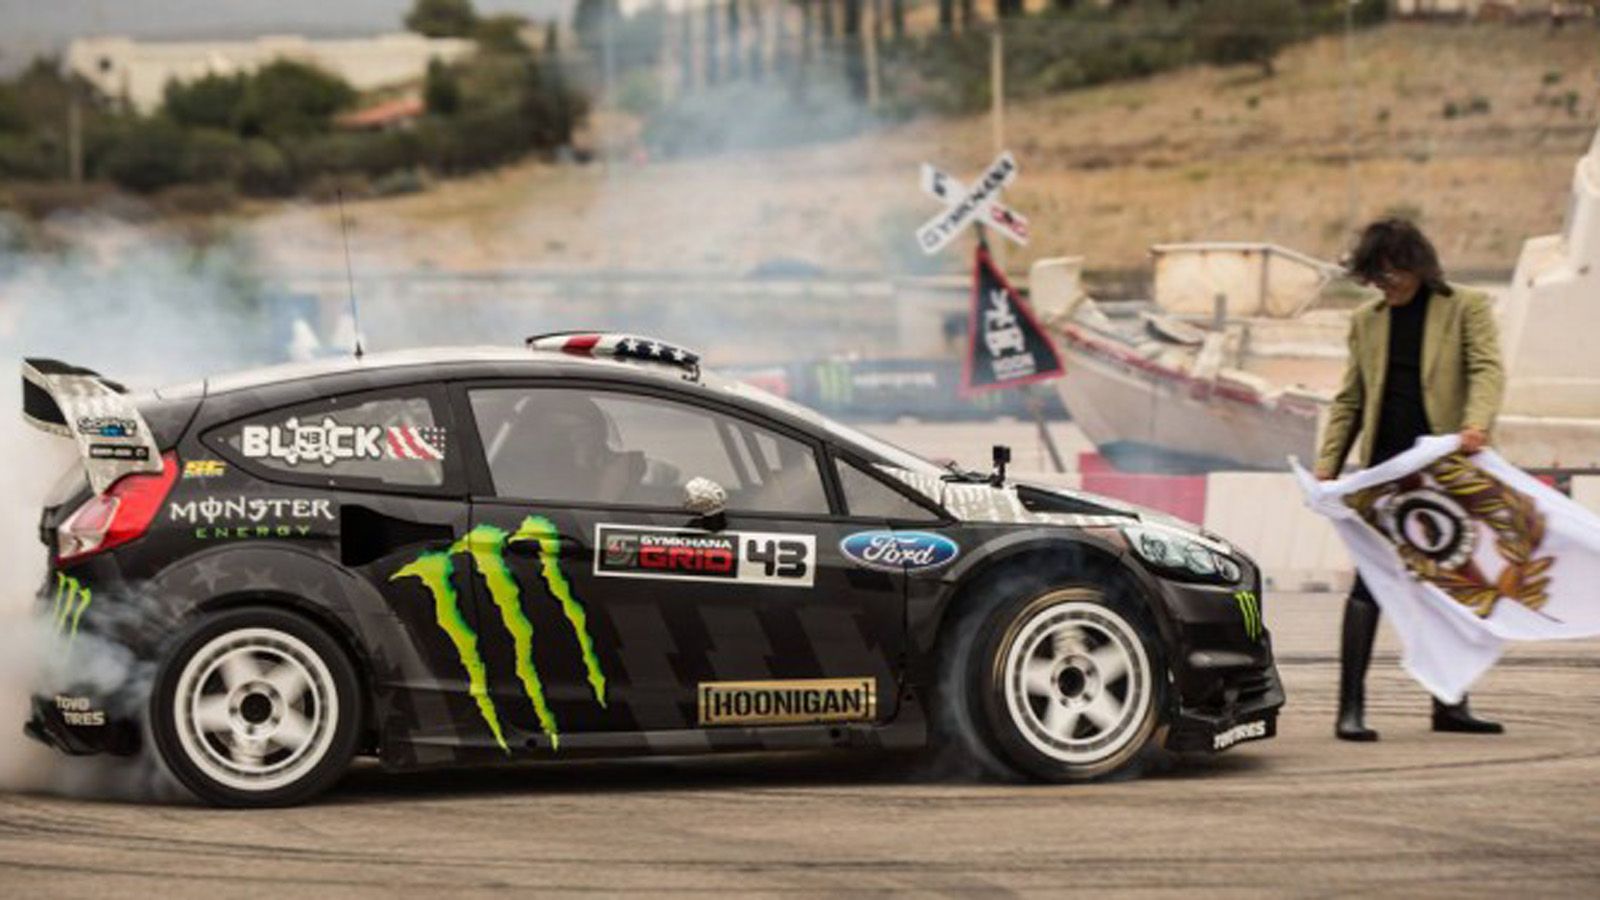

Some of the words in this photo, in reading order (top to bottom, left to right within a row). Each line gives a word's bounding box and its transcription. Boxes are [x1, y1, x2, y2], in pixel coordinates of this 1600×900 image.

[169, 496, 335, 524] MONSTER
[196, 525, 310, 539] ENERGY
[640, 535, 733, 548] GYMKHANA
[746, 539, 808, 577] 43
[862, 535, 936, 565] Ford
